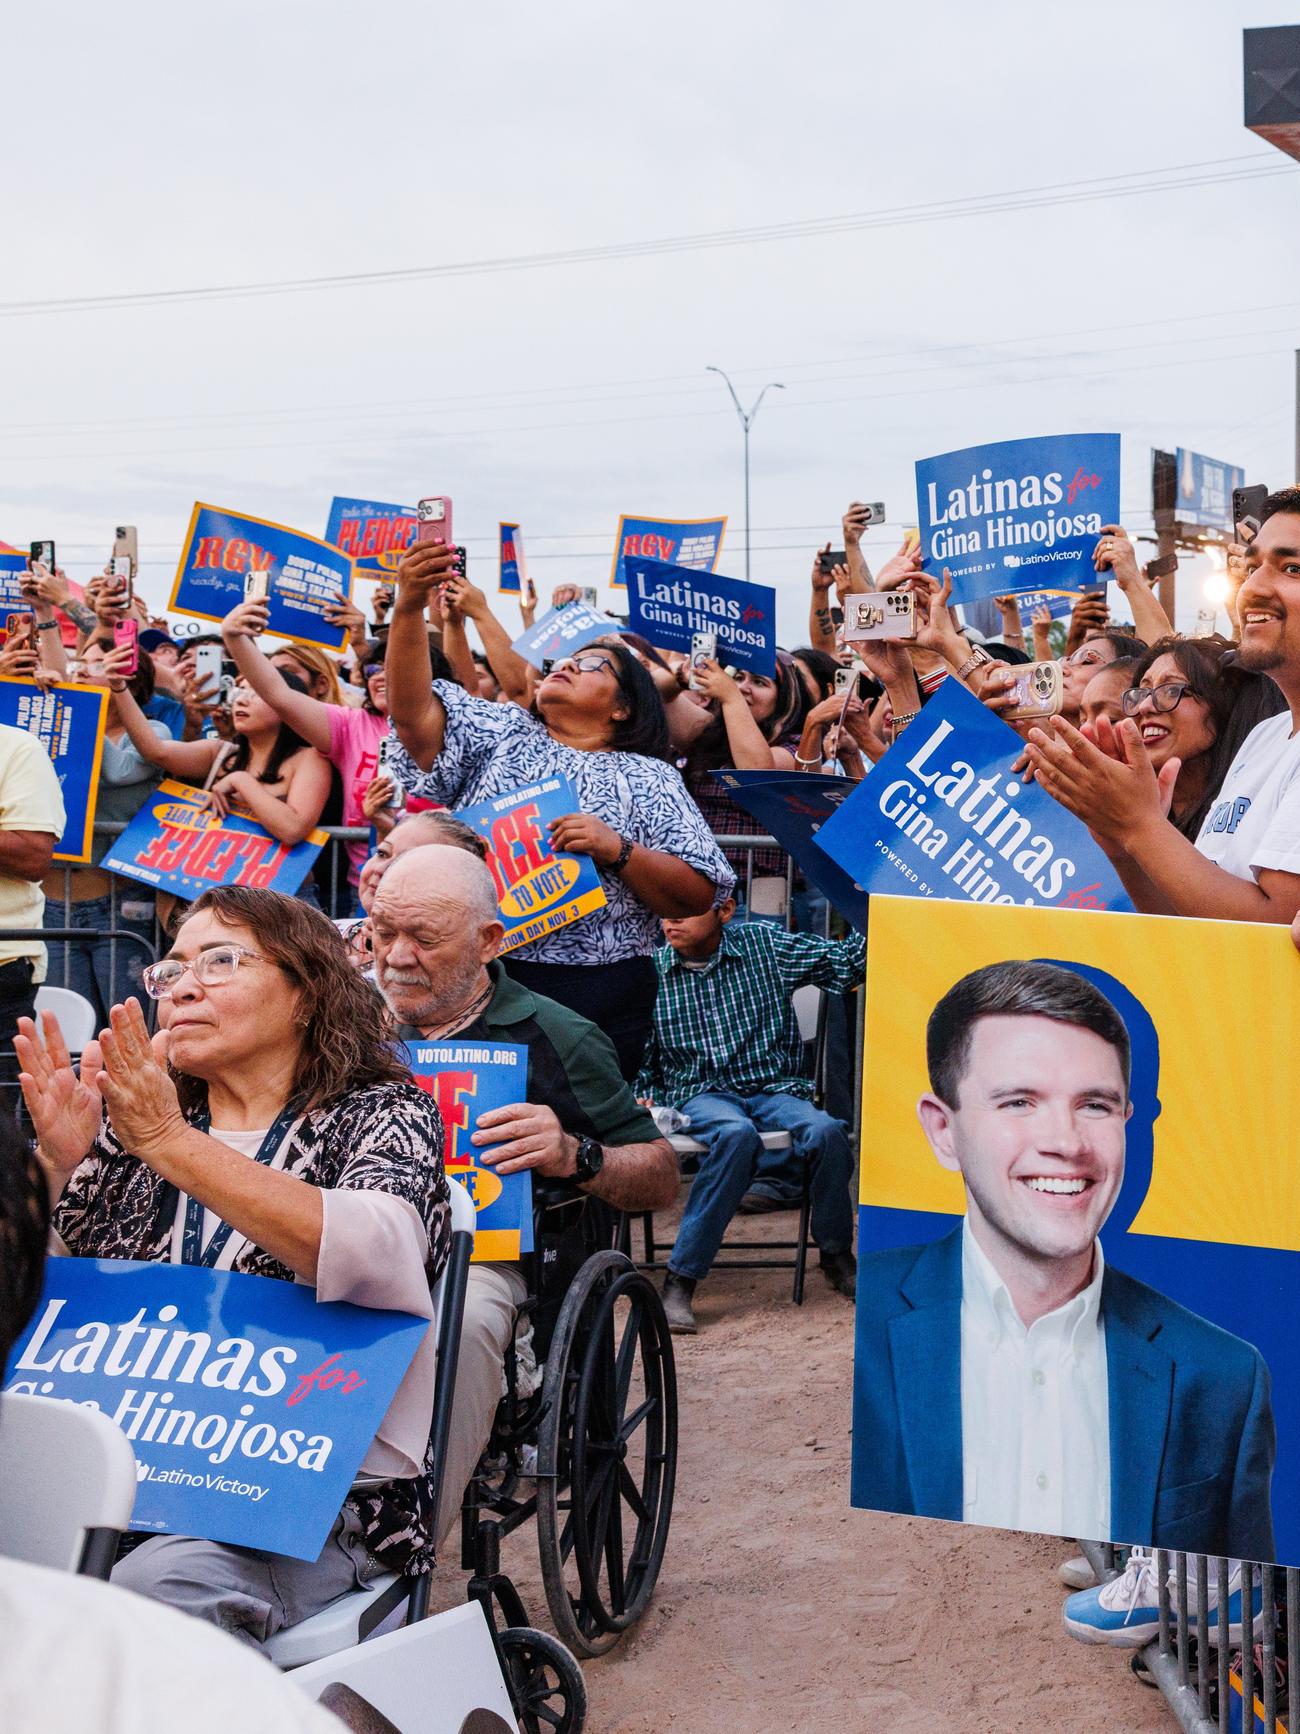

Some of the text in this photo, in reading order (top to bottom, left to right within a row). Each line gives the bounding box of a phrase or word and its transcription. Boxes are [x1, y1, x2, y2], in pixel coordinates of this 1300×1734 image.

[927, 466, 1103, 527] Latinas for
[931, 509, 1102, 560] Gina Hinojosa
[985, 562, 996, 570] BY
[1020, 550, 1083, 567] LatinoVictory
[636, 572, 741, 620] Latinas
[639, 601, 683, 627] Gina
[687, 611, 766, 648] Hinojosa
[163, 805, 192, 827] VOTE
[492, 779, 561, 811] VOTOLATINO.ORG
[905, 718, 1076, 899] Latinas
[878, 780, 949, 861] Gina
[511, 862, 570, 912] TO VOTE
[874, 839, 934, 896] POWERED BY
[527, 922, 545, 940] DAY
[549, 912, 572, 929] NOV.
[573, 905, 580, 916] 3
[417, 1048, 517, 1065] VOTOLATINO.ORG
[14, 1298, 298, 1398] Latinas
[286, 1353, 368, 1408] for
[112, 1388, 334, 1473] Hinojosa
[147, 1465, 270, 1503] LatinoVictory
